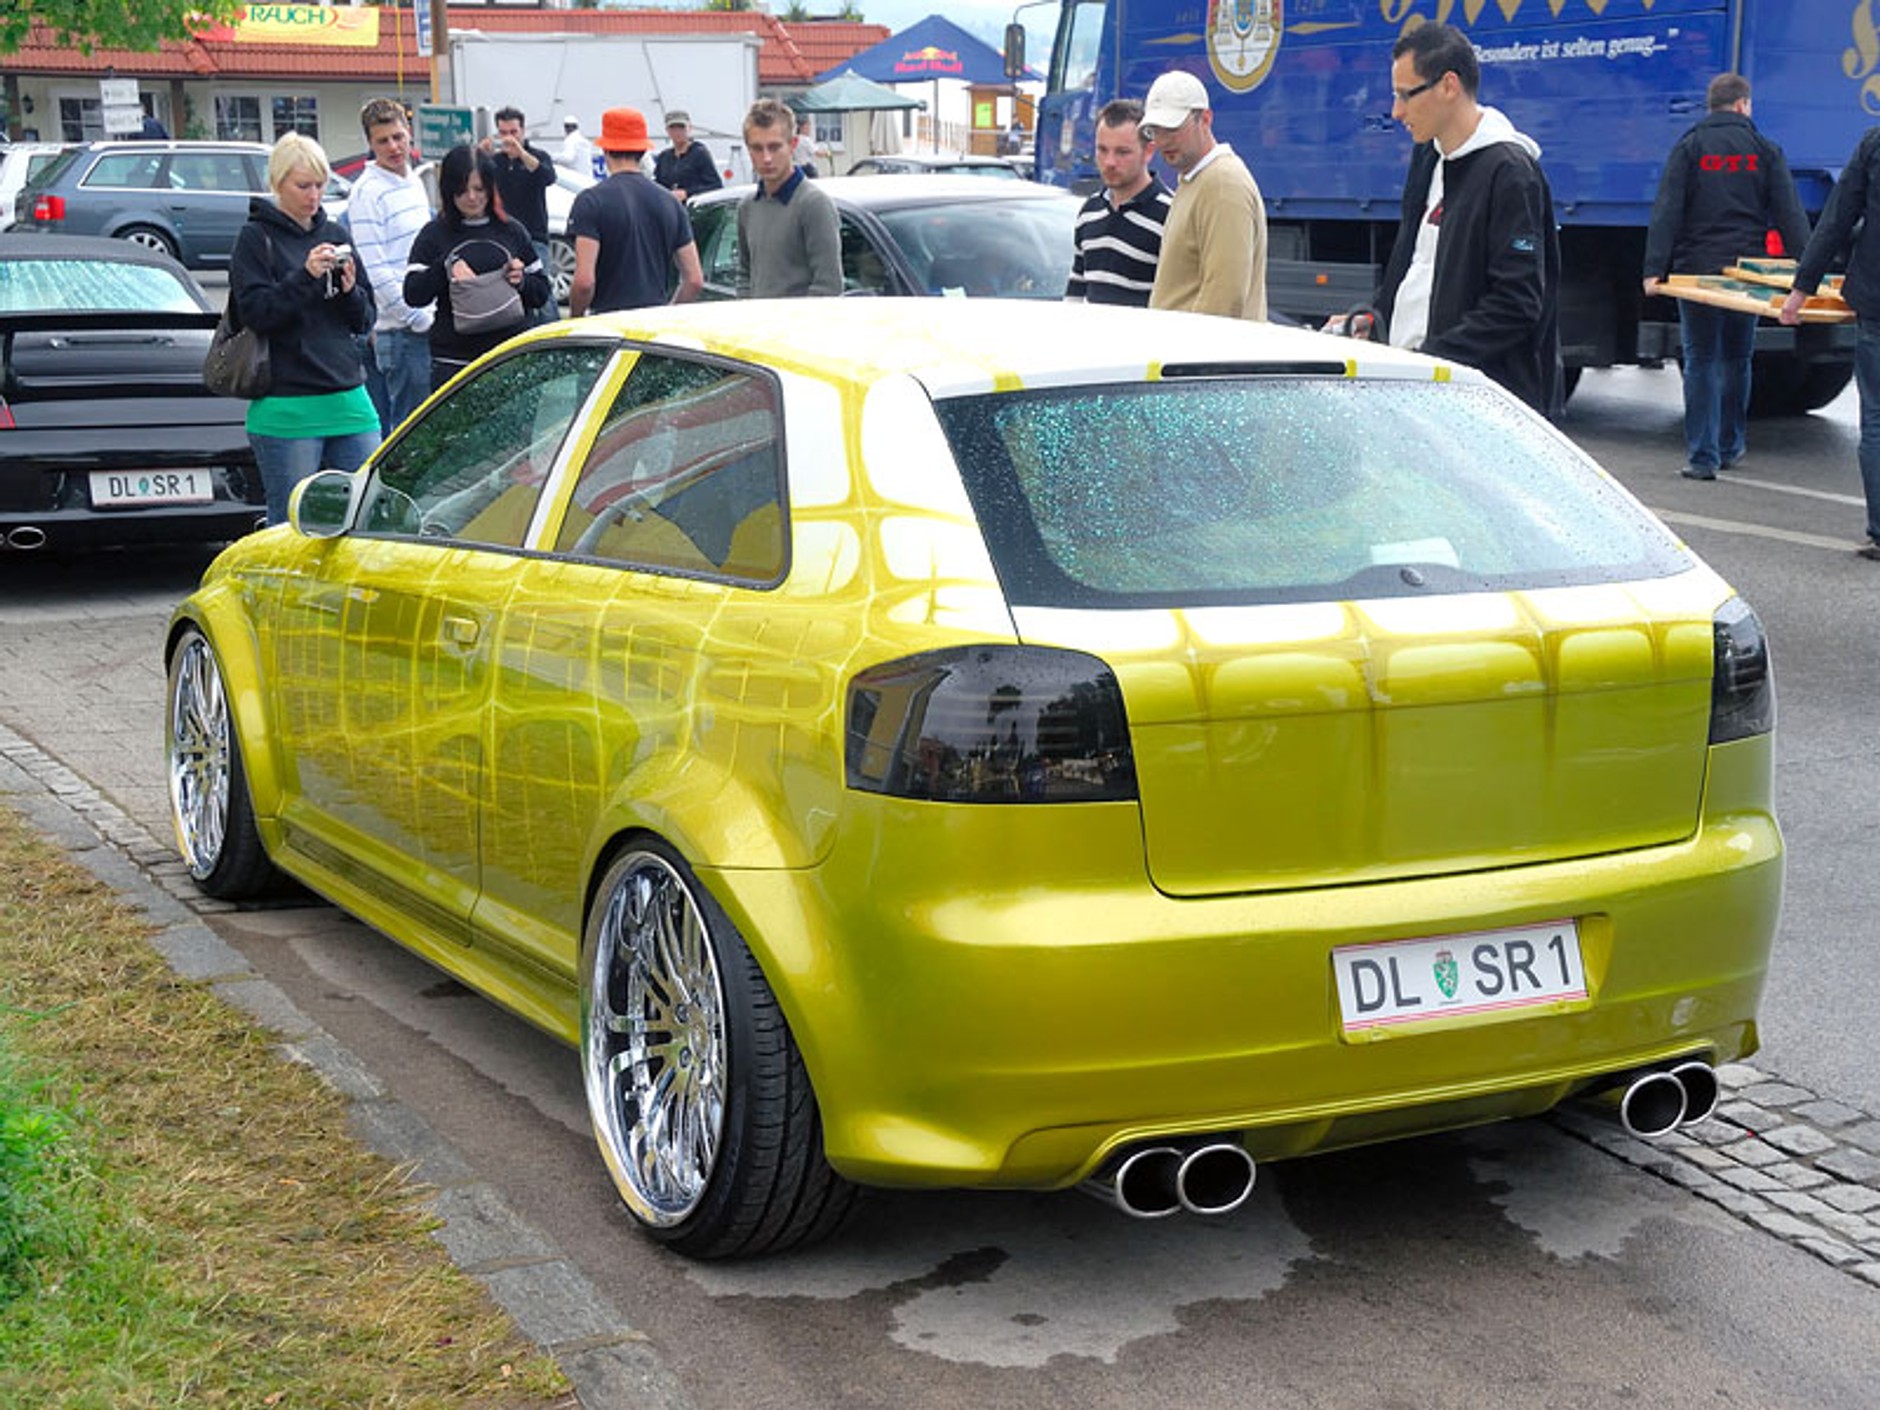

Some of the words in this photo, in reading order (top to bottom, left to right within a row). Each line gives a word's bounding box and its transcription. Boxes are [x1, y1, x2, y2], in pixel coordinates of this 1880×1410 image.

[250, 5, 326, 25] RAUCH
[1541, 40, 1559, 58] ist
[1561, 37, 1605, 57] selten
[1699, 153, 1759, 172] GTI
[108, 476, 136, 497] DL
[152, 474, 182, 495] SR
[185, 474, 196, 494] 1
[1350, 956, 1422, 1014] DL
[1471, 939, 1542, 996] SR
[1548, 934, 1571, 986] 1
